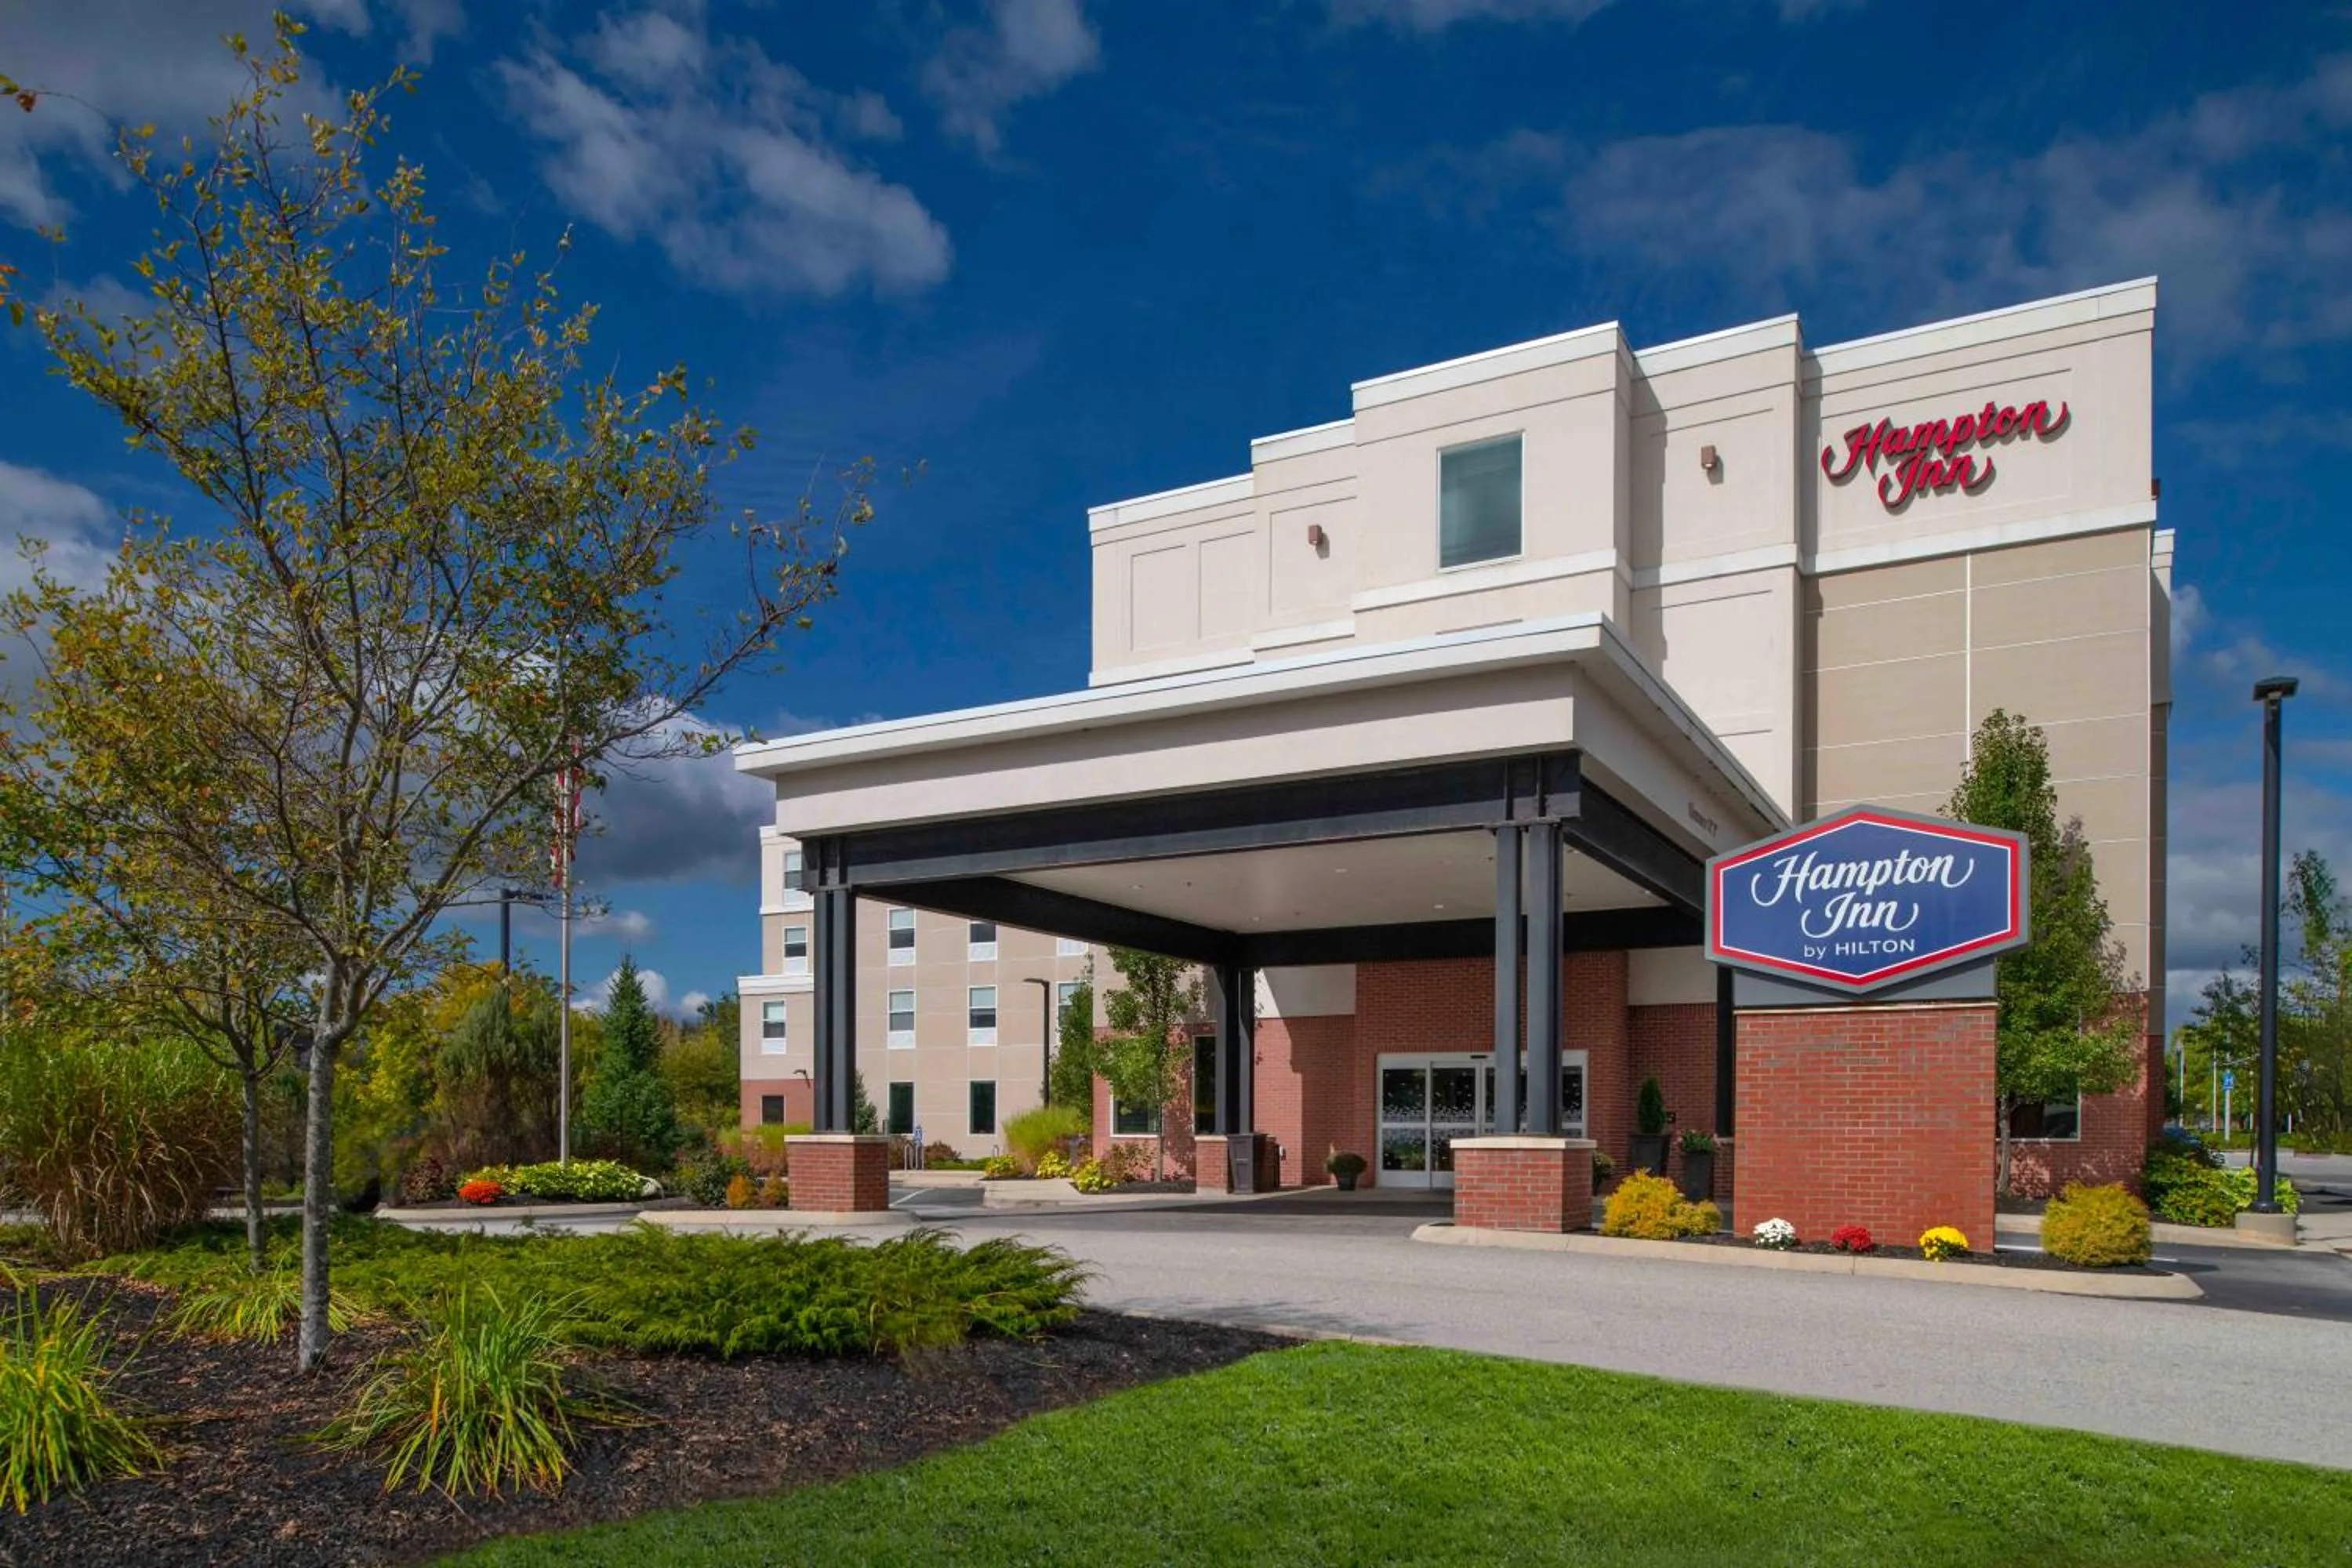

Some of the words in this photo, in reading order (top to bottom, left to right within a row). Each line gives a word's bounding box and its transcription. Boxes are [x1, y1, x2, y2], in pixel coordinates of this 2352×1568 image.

[1821, 400, 2071, 479] Hampton
[1878, 450, 1993, 509] Inn
[1751, 849, 1974, 906] Hampton
[1801, 891, 1919, 938] Inn
[1804, 944, 1826, 960] by
[1835, 939, 1915, 956] HILTON
